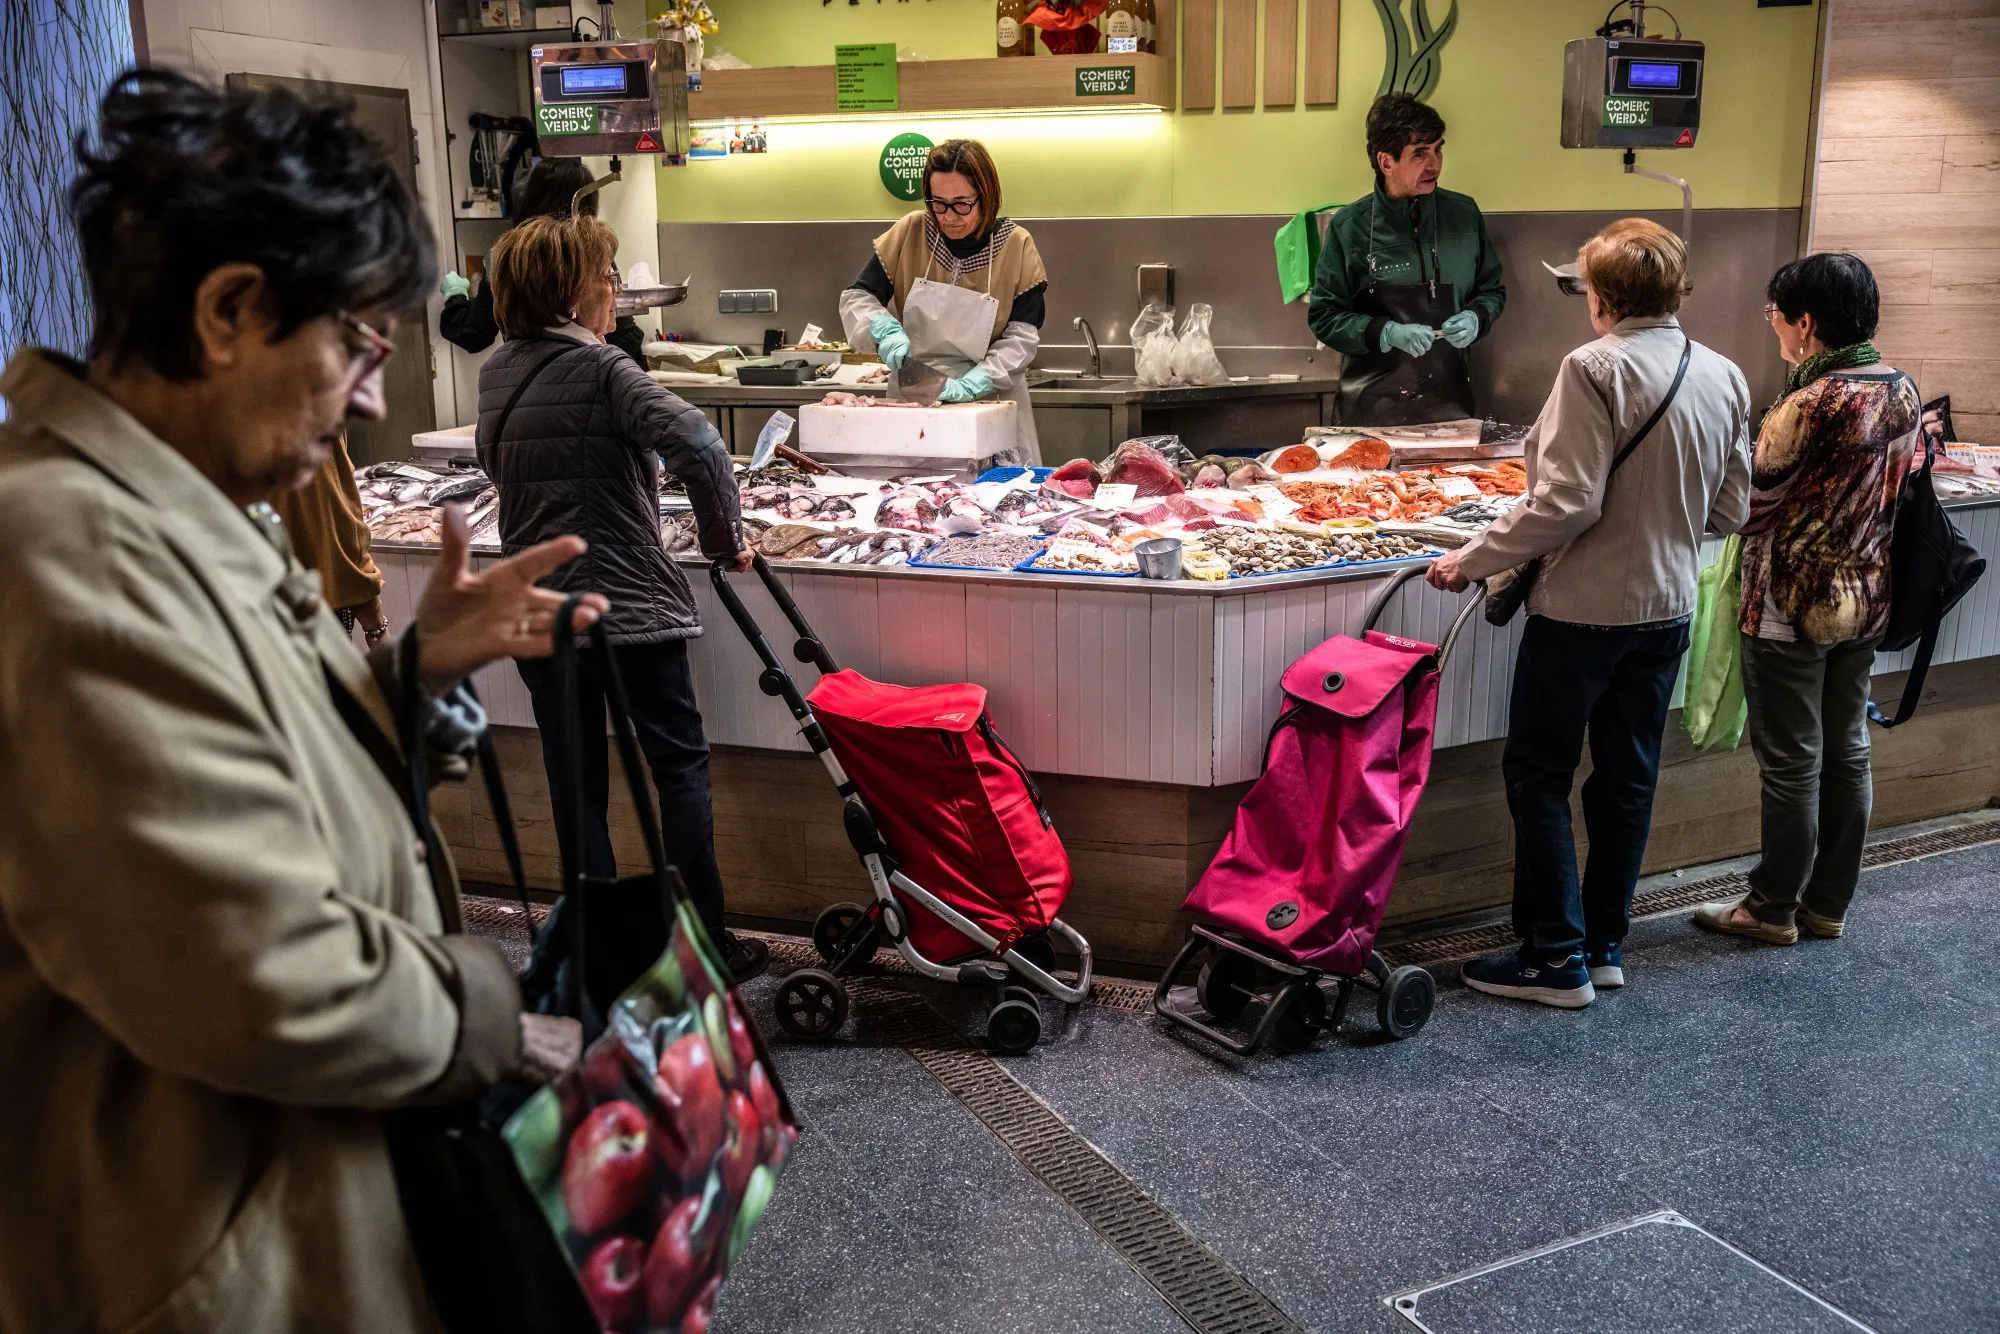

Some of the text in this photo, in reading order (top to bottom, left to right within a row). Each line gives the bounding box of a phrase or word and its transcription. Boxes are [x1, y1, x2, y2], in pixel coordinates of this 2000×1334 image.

[1079, 69, 1131, 83] COMERÇ
[1083, 81, 1116, 92] VERD
[539, 106, 594, 122] COMERÇ
[1606, 99, 1650, 116] COMERÇ
[1608, 112, 1637, 124] VERD
[544, 119, 579, 133] VERD
[889, 145, 931, 157] RACÓ DE
[883, 156, 928, 168] COMER
